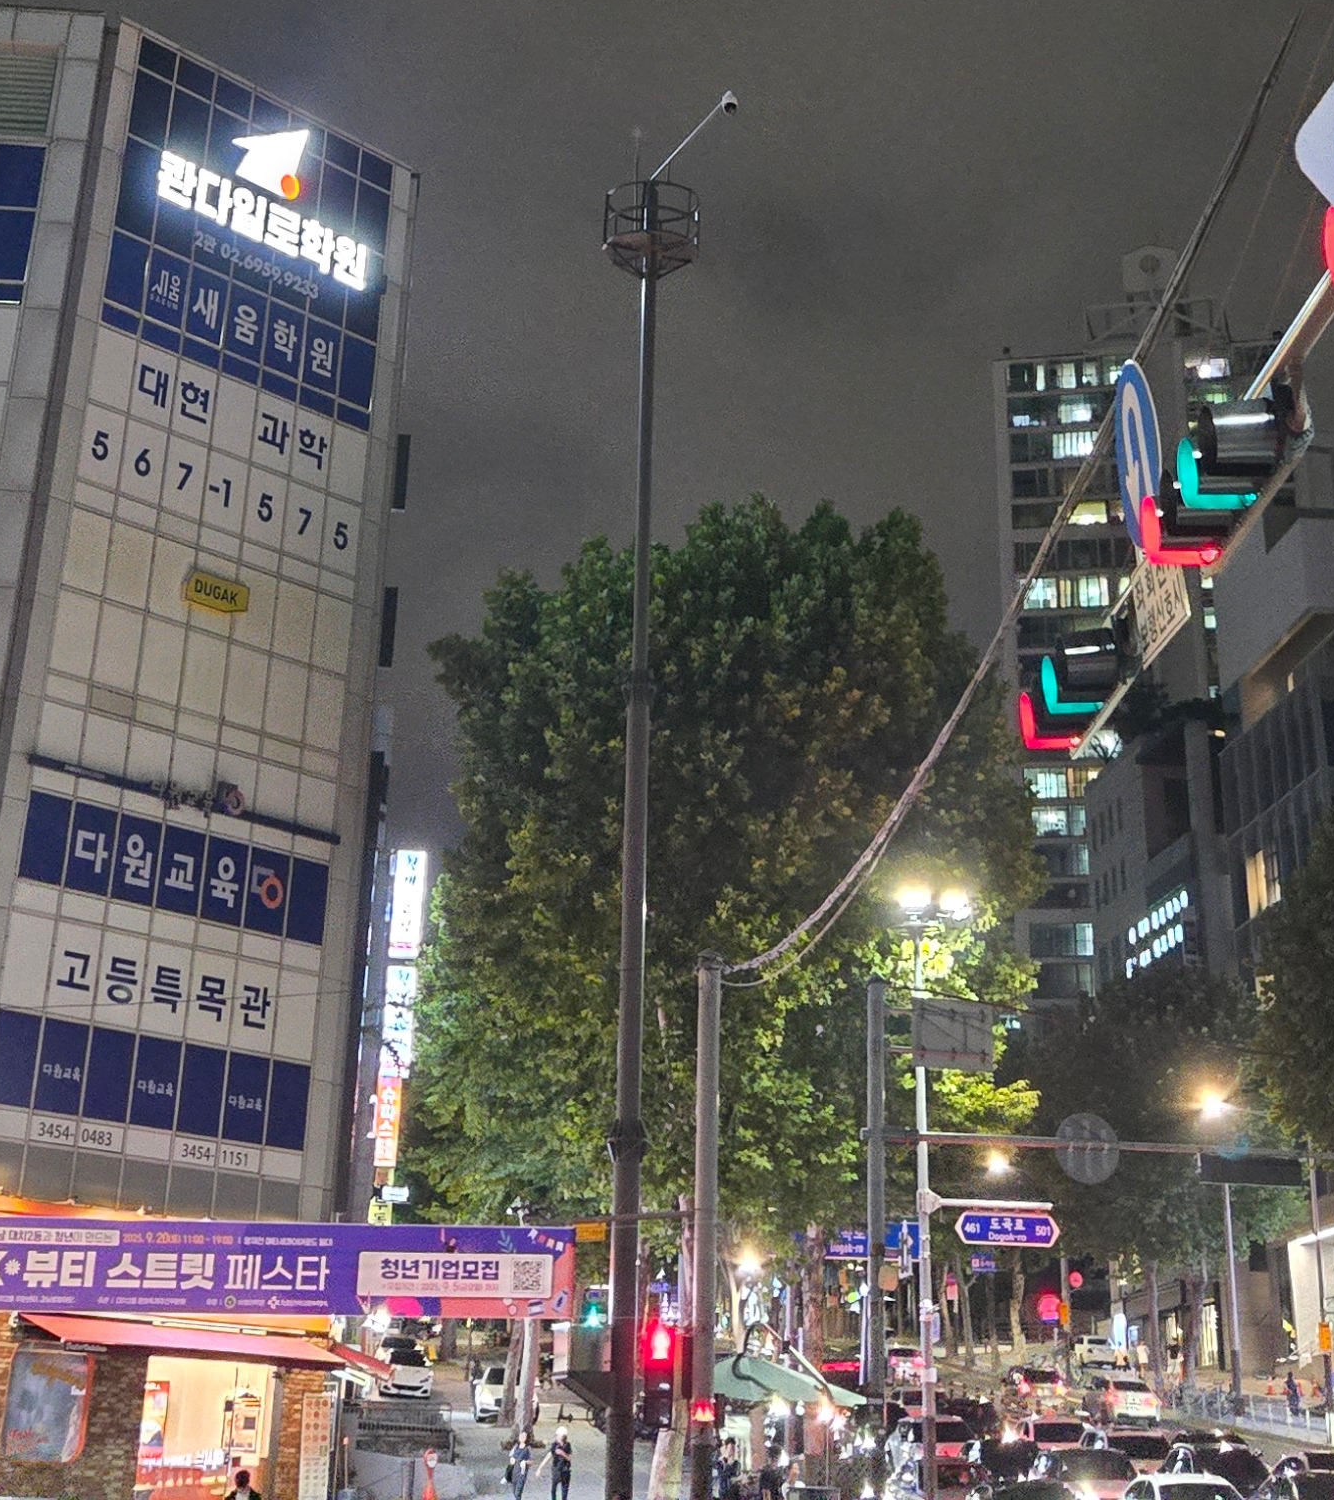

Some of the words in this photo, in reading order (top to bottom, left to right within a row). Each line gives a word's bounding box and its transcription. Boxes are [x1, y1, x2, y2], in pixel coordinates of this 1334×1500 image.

[192, 285, 334, 377] 새움학원
[138, 364, 210, 426] 대현
[257, 411, 328, 471] 과학
[194, 578, 239, 607] DUGAK
[74, 829, 239, 908] 다원교육
[56, 950, 271, 1031] 고등특목관
[42, 1063, 82, 1082] 다원교육
[137, 1079, 175, 1097] 다원교육
[964, 1222, 980, 1234] 461
[989, 1217, 1025, 1231] 도곡로
[1035, 1225, 1051, 1237] 501
[988, 1231, 1027, 1243] Dogok-ro
[105, 1252, 215, 1290] 스트릿
[224, 1254, 330, 1291] 페스타
[381, 1258, 499, 1280] 청년기업모집
